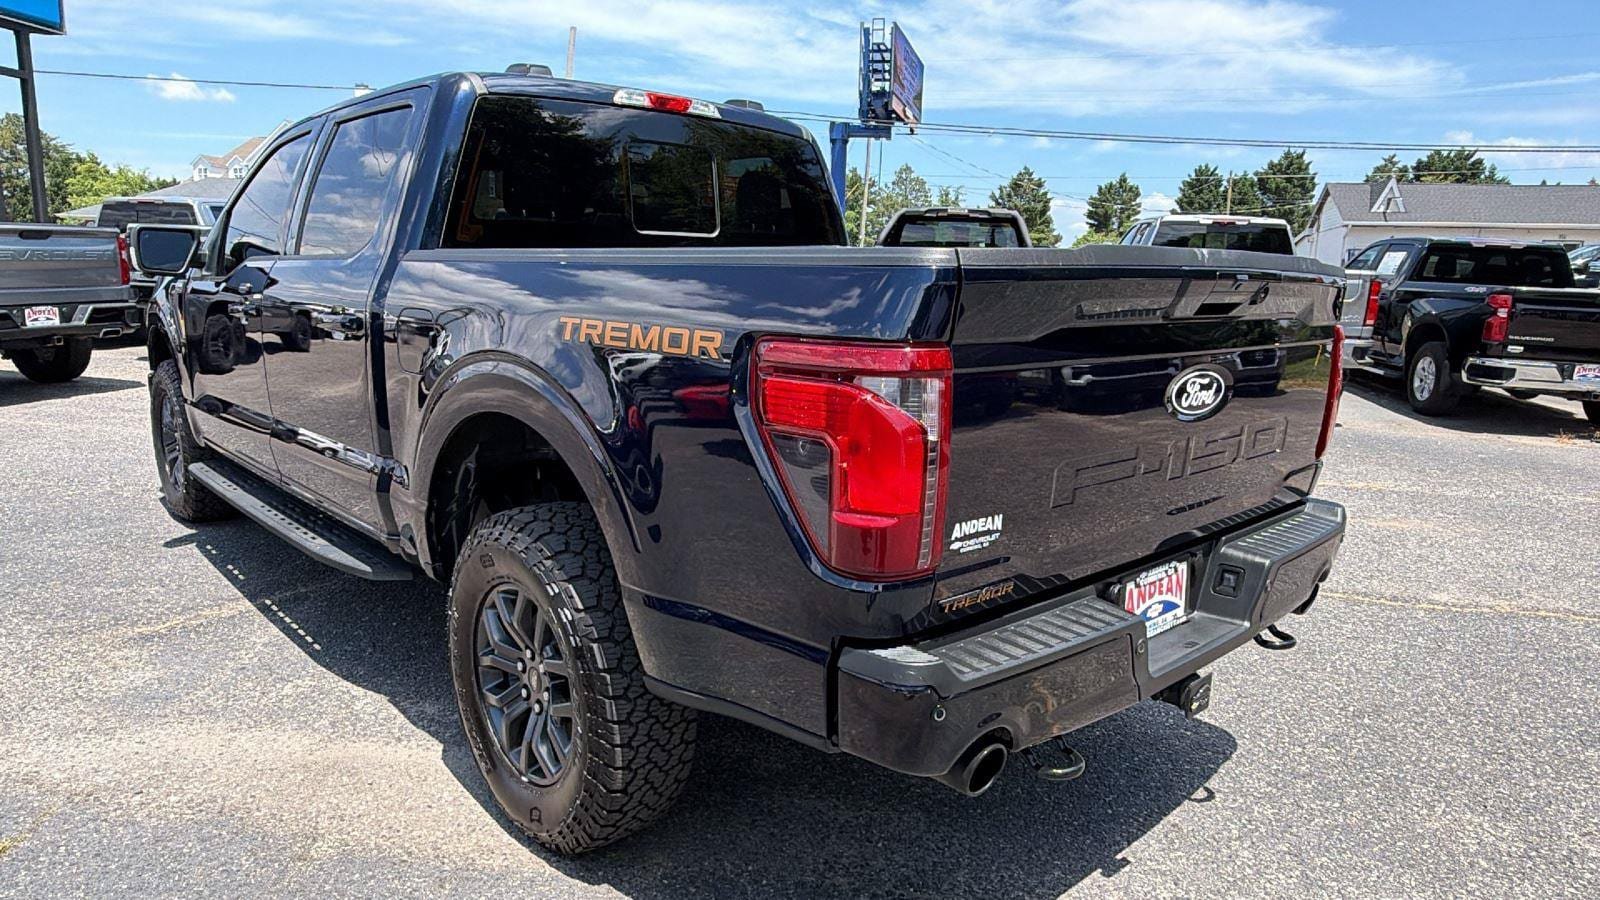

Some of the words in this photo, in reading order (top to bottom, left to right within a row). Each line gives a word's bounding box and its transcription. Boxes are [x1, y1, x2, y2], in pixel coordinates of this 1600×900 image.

[559, 316, 723, 360] TREMOR
[1181, 376, 1217, 408] Ford
[951, 513, 1003, 541] ANDEAN
[943, 581, 1014, 613] TREMOR
[1125, 567, 1184, 614] ANDEAN
